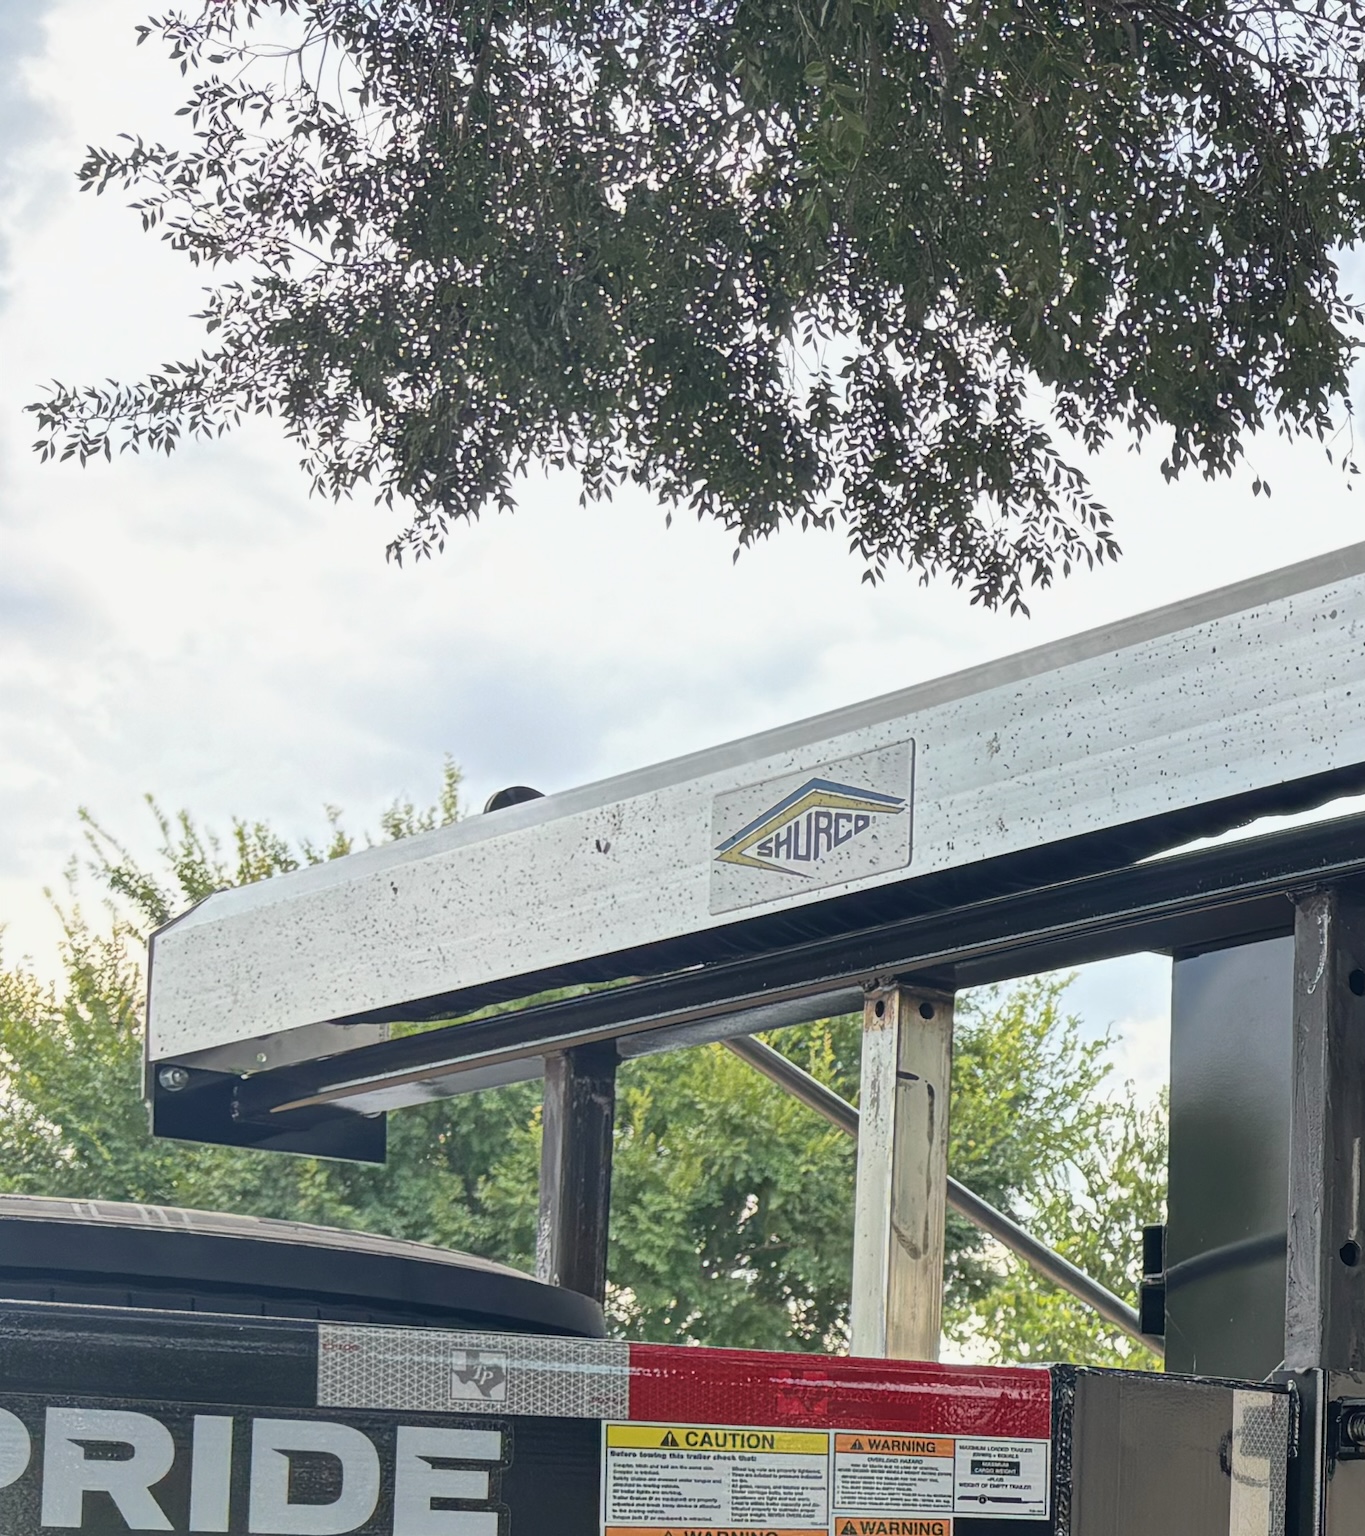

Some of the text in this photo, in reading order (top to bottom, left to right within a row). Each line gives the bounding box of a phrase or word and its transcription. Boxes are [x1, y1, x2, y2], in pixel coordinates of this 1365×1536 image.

[756, 811, 871, 862] SHURCO
[685, 1431, 775, 1449] CAUTION
[868, 1439, 936, 1453] WARNING
[860, 1521, 944, 1536] WARNING
